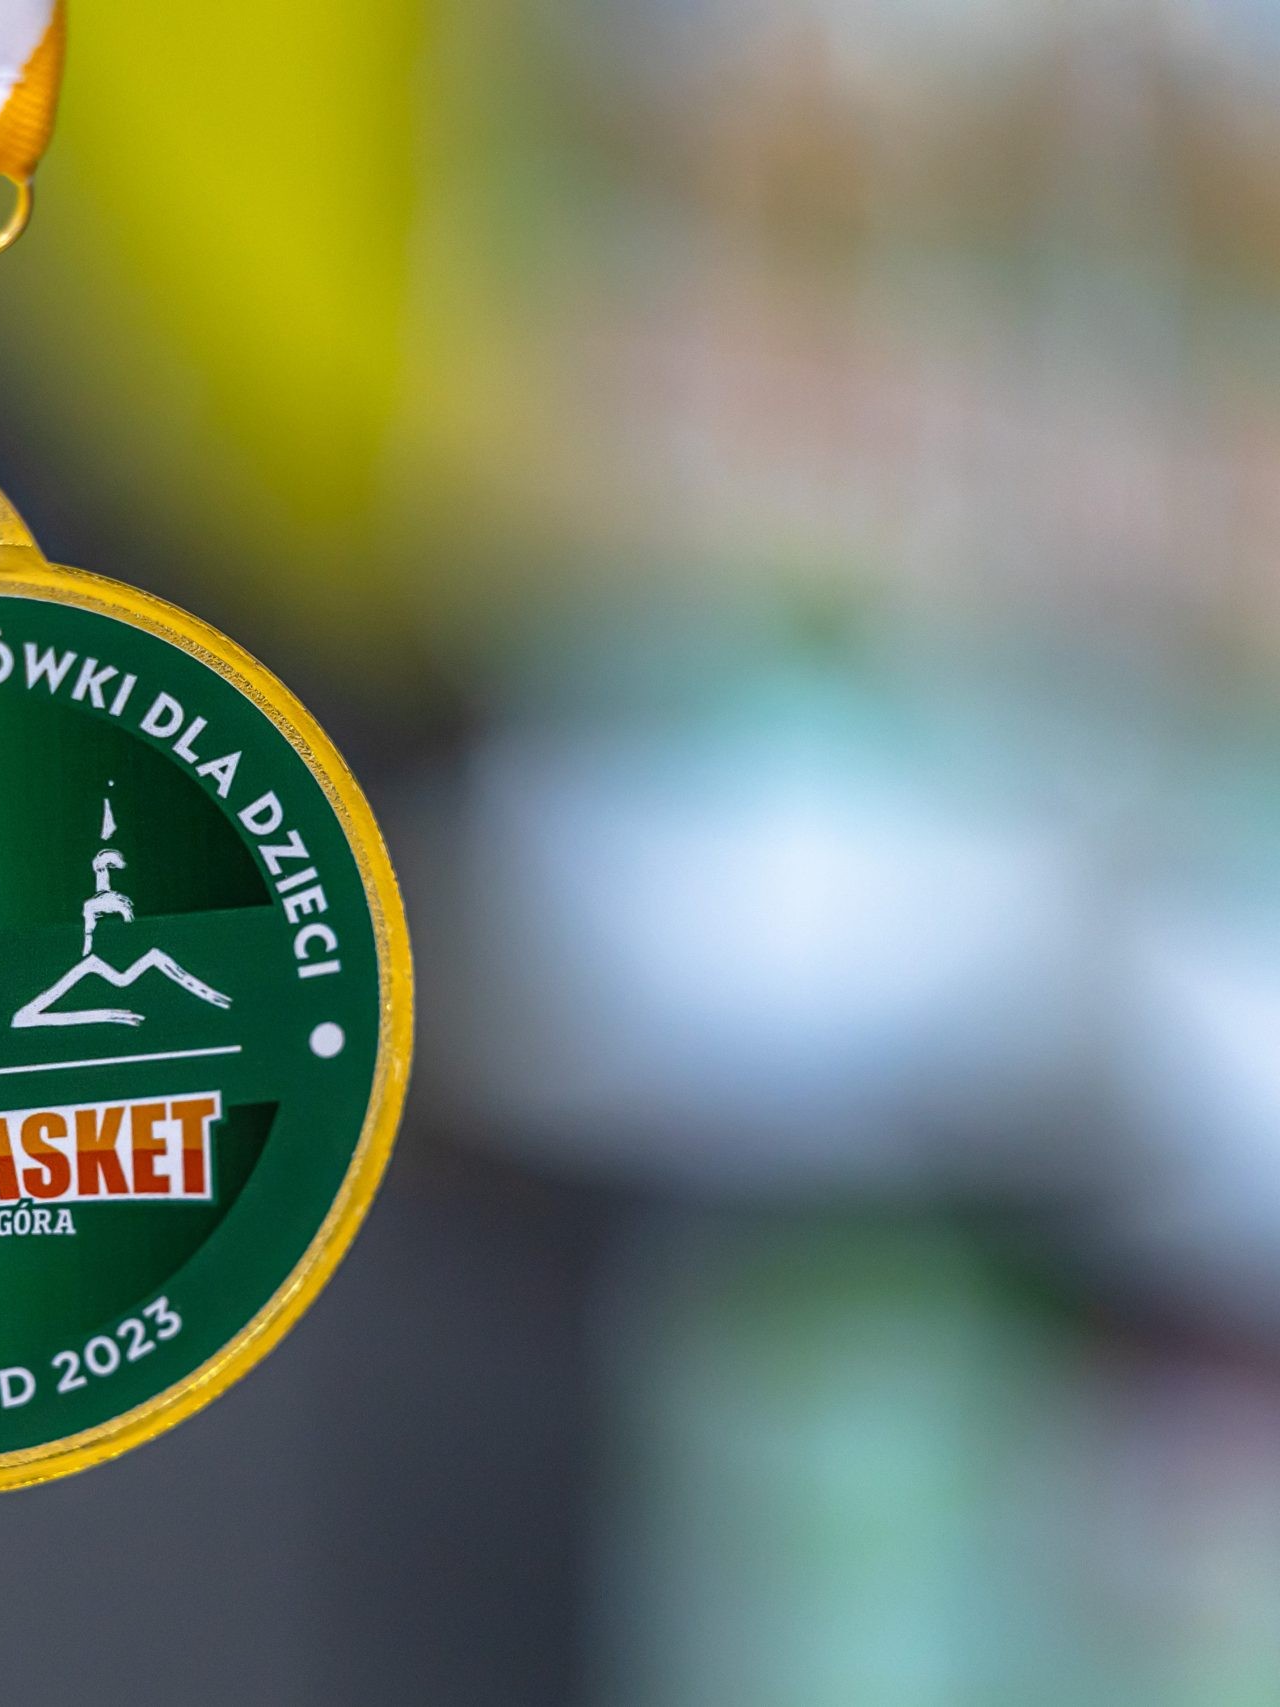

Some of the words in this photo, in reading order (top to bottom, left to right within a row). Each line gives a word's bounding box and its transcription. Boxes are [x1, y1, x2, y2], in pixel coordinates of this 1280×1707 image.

[139, 691, 243, 798] DLA
[236, 790, 342, 980] DZIECI
[51, 1295, 183, 1394] 2023
